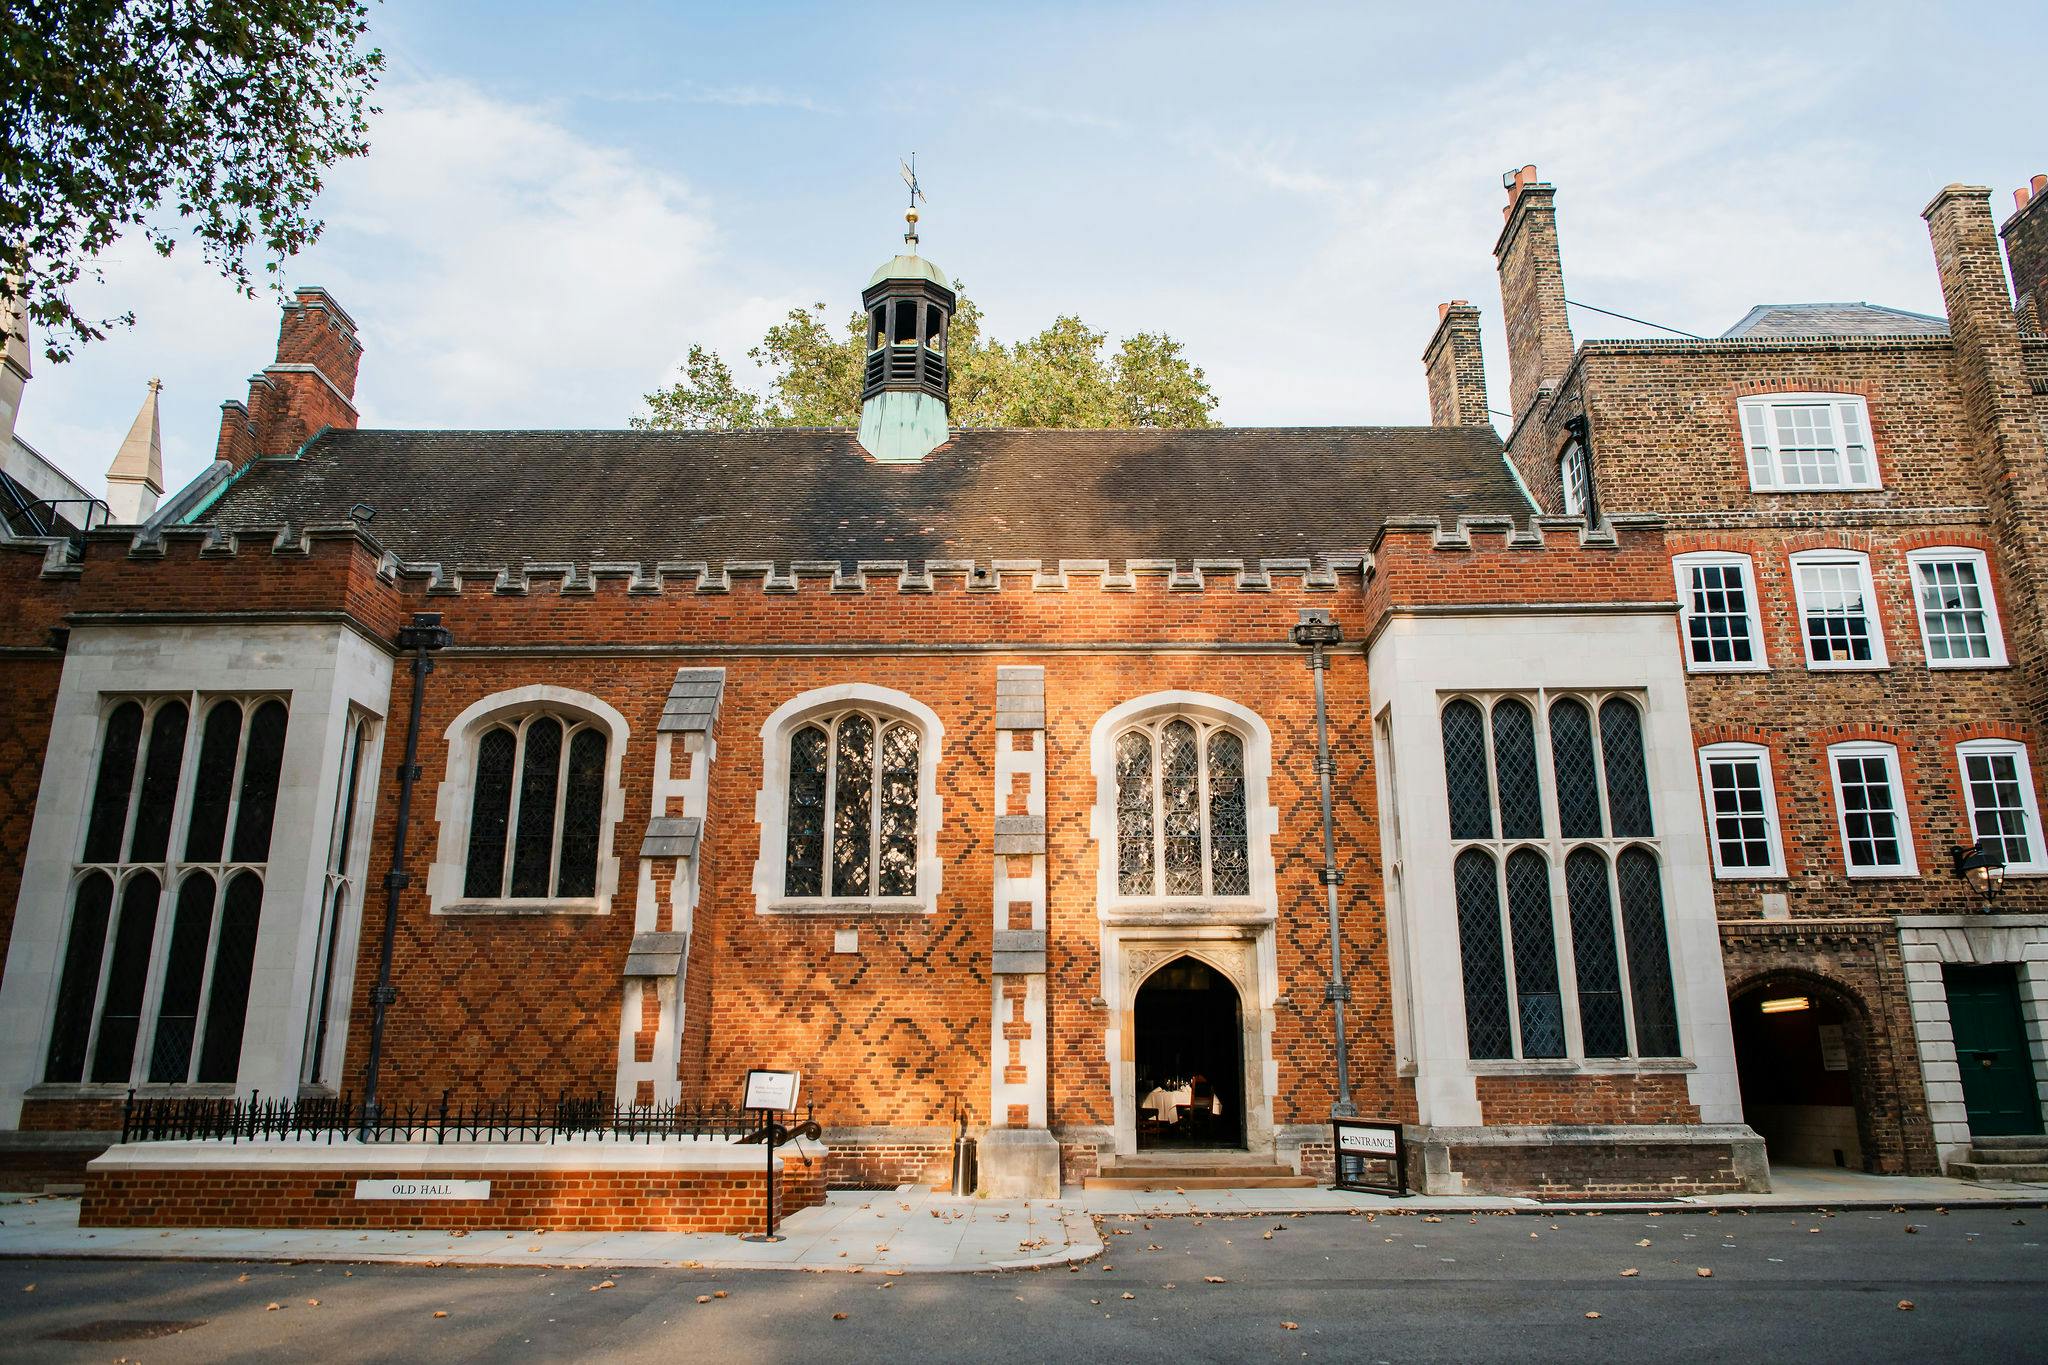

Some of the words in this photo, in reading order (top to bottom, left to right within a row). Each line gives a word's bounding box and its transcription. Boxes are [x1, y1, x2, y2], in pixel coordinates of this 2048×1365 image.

[1349, 1135, 1394, 1148] ENTRANCE
[392, 1184, 417, 1195] OLD
[420, 1184, 452, 1195] HALL
